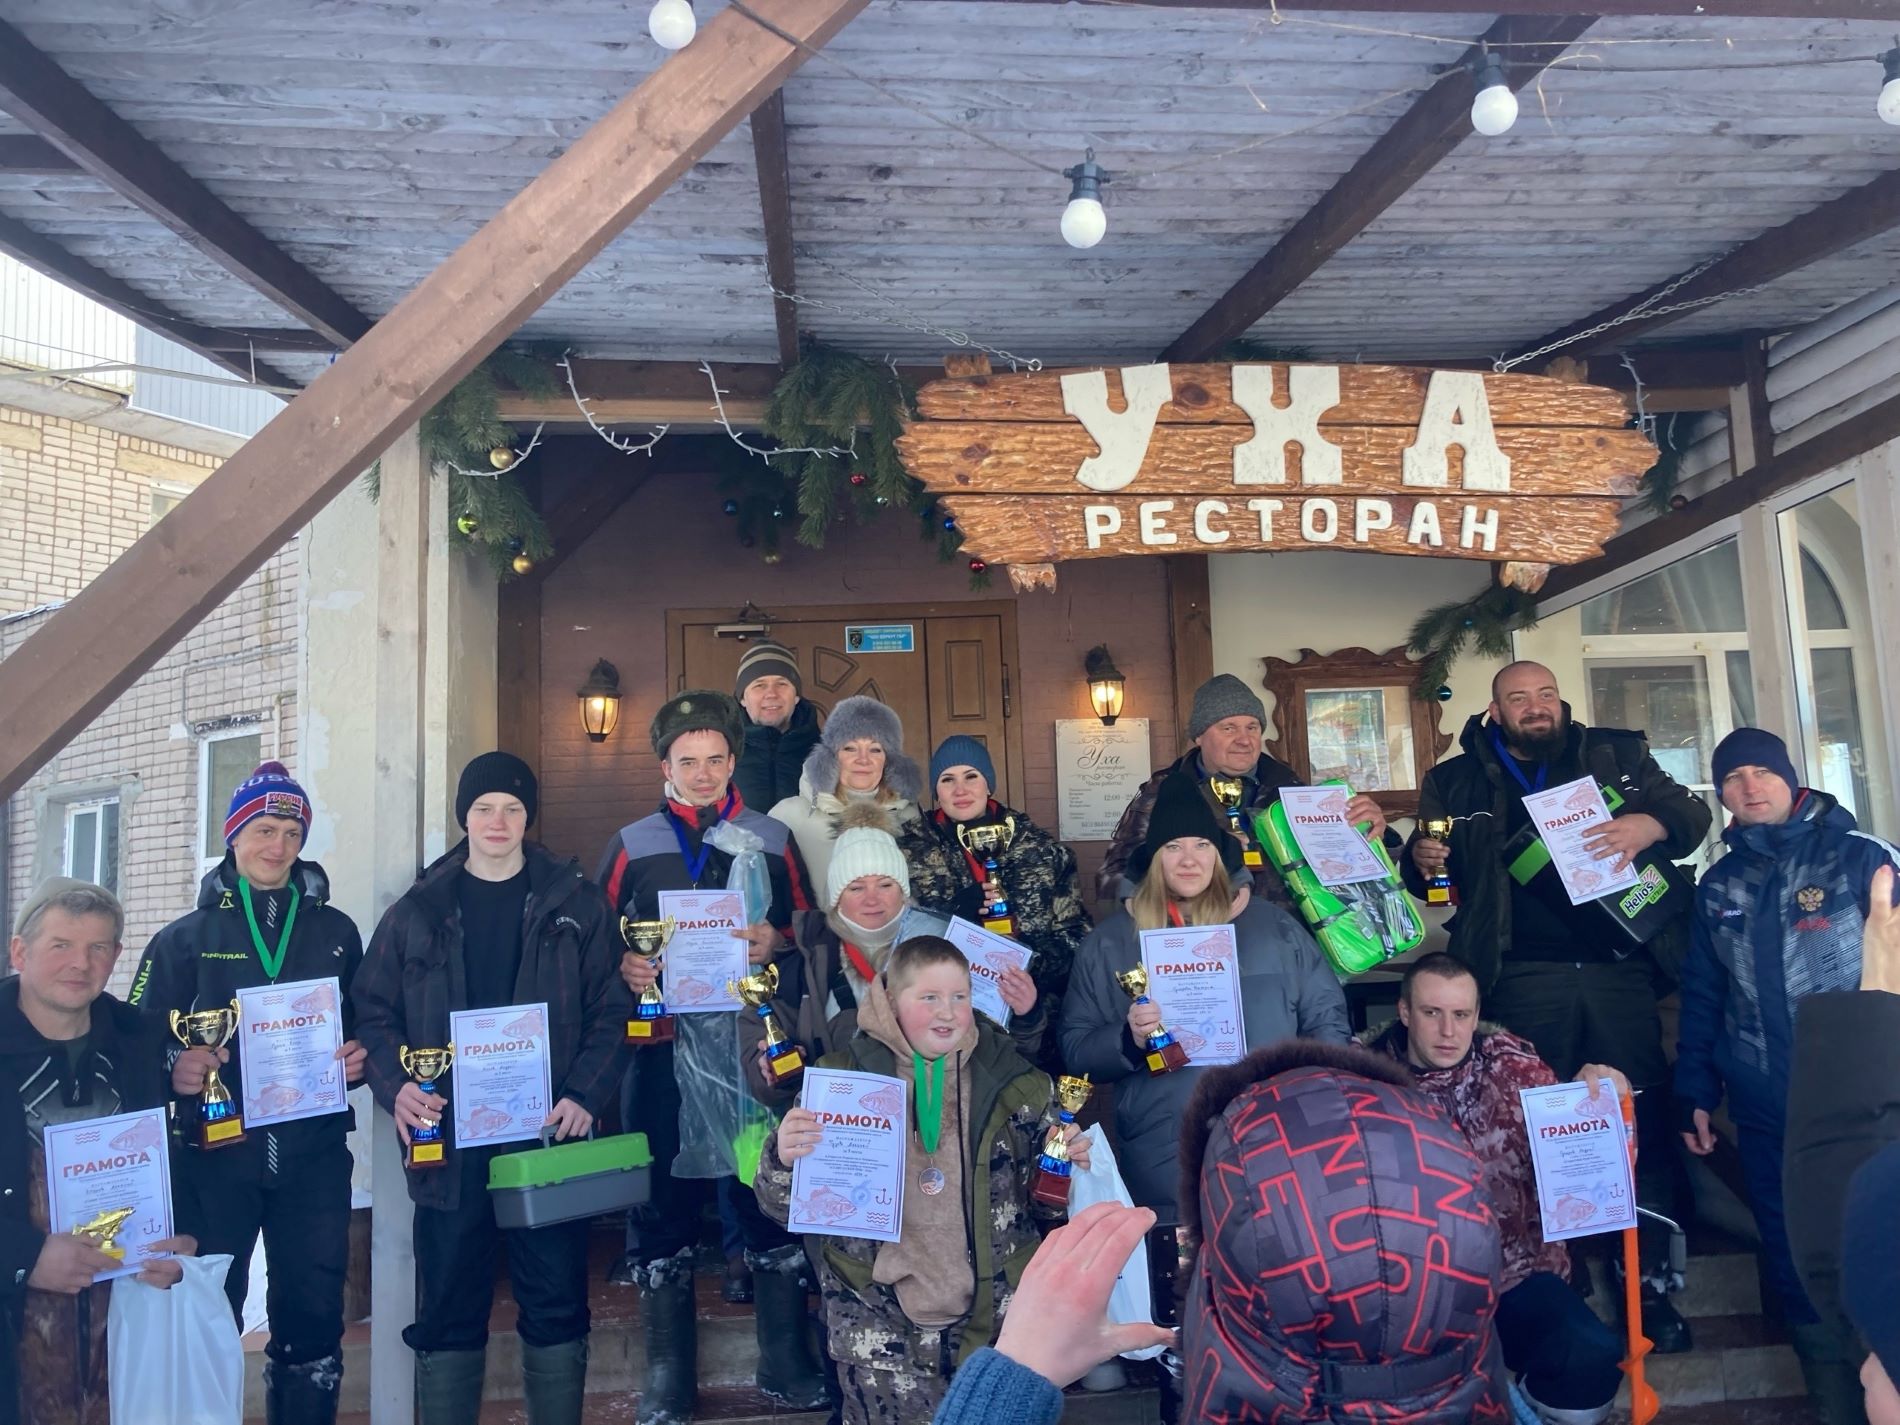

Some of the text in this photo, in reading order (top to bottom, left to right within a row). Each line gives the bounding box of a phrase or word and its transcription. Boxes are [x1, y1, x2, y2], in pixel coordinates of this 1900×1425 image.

[1060, 362, 1511, 493] УХА
[1084, 499, 1500, 553] РЕСТОРАН
[1077, 745, 1121, 769] Уха
[1295, 814, 1343, 825] ГРАМОТА
[1544, 808, 1597, 831] ГРАМОТА
[1624, 882, 1655, 913] Helios
[675, 919, 735, 930] РАМОТА
[1155, 961, 1225, 975] ГРАМОТА
[252, 1013, 328, 1034] ГРАМОТА
[464, 1039, 536, 1056] ГРАМОТА
[1540, 1118, 1610, 1139] ГРАМОТА
[63, 1151, 152, 1178] ГРАМОТА
